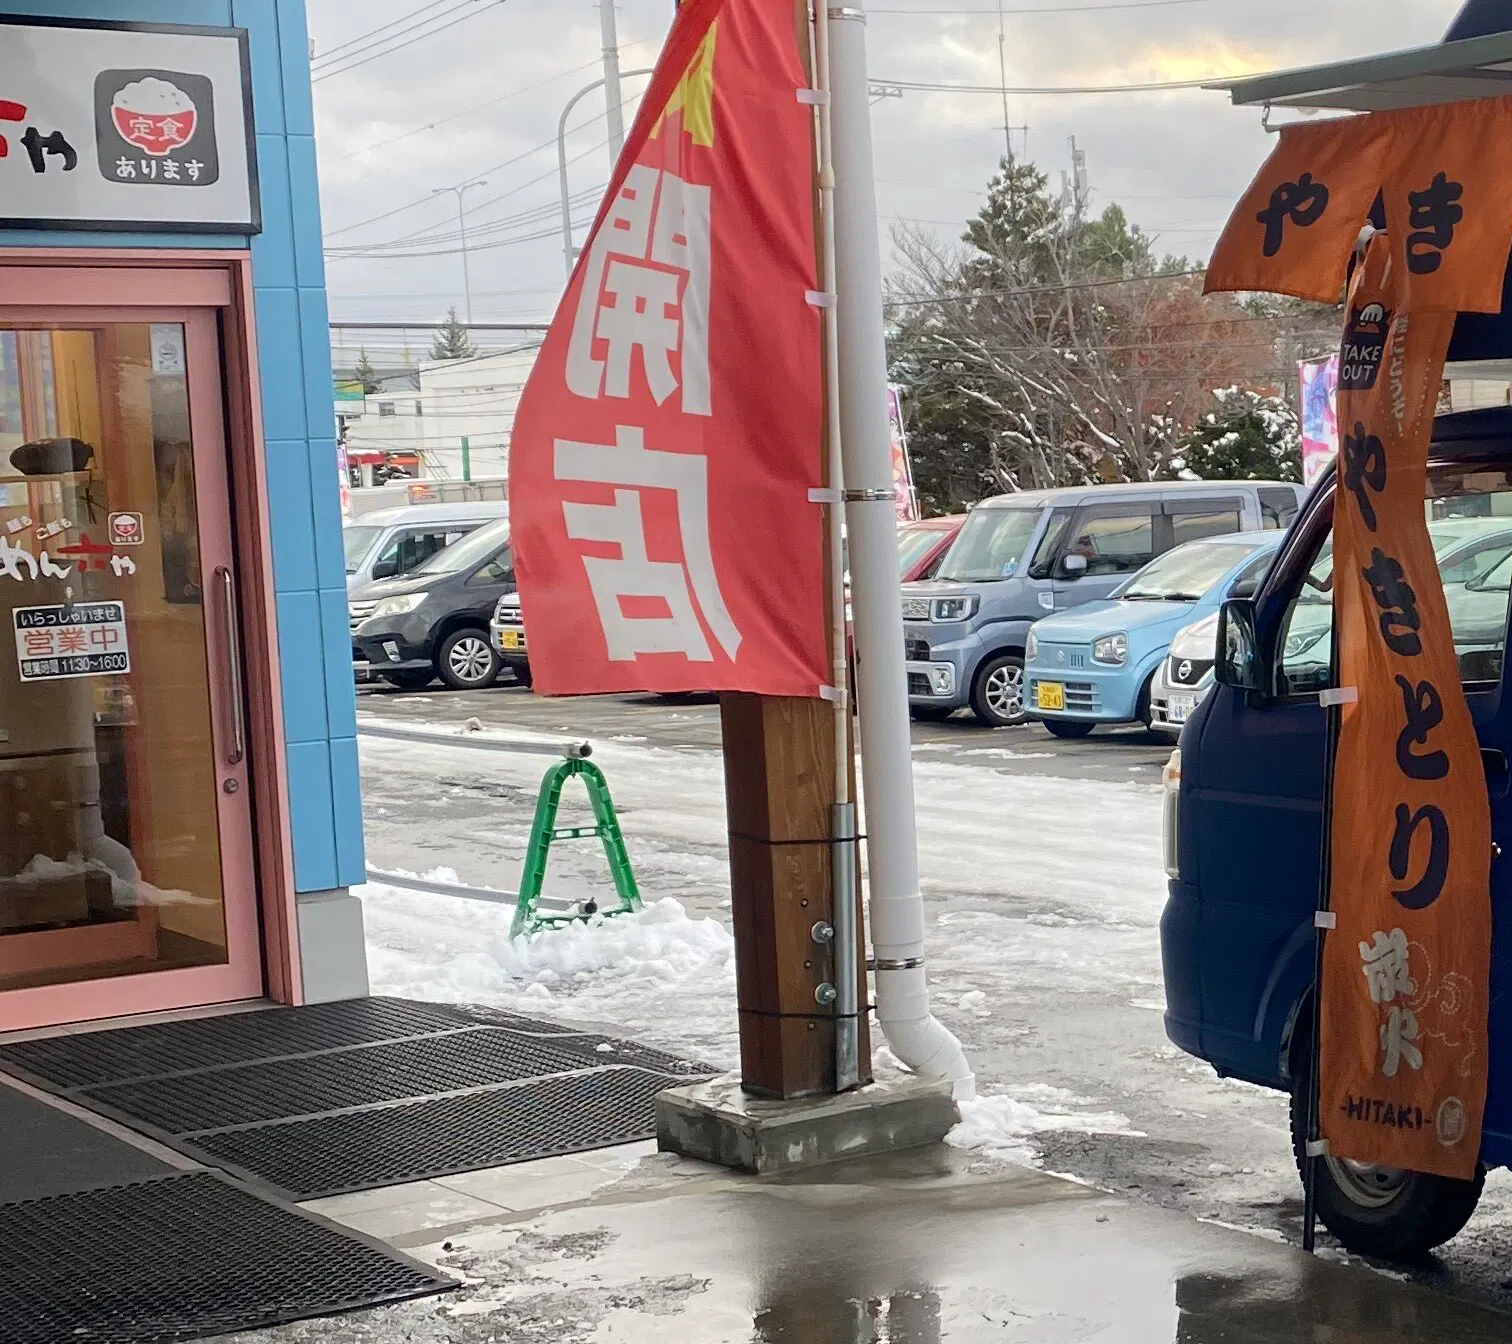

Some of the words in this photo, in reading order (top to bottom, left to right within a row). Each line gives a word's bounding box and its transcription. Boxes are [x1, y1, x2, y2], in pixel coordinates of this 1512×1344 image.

[128, 117, 184, 142] 定食
[115, 155, 205, 182] あります
[1343, 344, 1382, 361] TAKE
[1341, 364, 1374, 381] OUT
[20, 606, 117, 627] いらっしゃいませ
[24, 624, 119, 656] 営業中
[1343, 420, 1451, 911] やきとり
